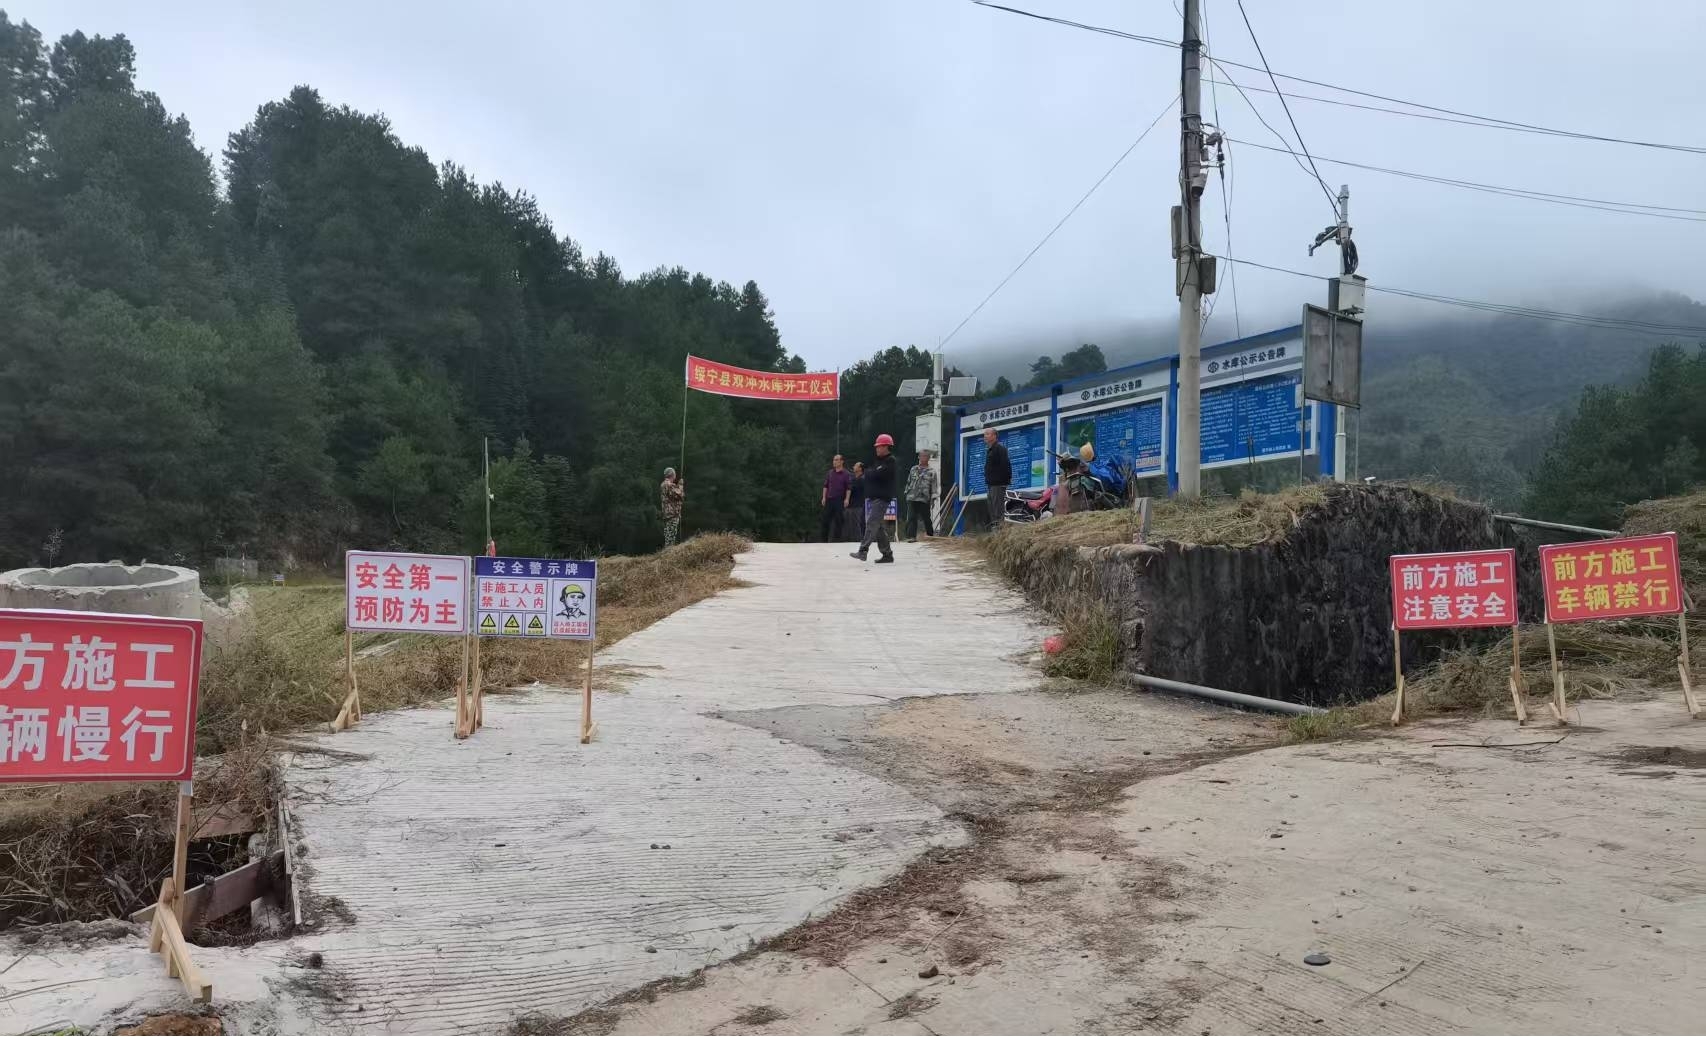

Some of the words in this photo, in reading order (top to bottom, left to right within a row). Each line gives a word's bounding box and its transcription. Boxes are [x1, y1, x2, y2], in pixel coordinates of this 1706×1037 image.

[1222, 347, 1286, 370] 水库公示公告牌
[694, 365, 833, 395] 绥宁县双冲水库开工仪式
[355, 562, 458, 591] 安全第一
[492, 560, 578, 576] 安全警示牌
[1401, 561, 1505, 590] 前方施工
[1552, 546, 1667, 581] 前方施工
[481, 581, 545, 595] 非施工人员
[481, 596, 544, 608] 禁止入内
[1556, 579, 1671, 613] 车辆禁行
[354, 596, 457, 625] 预防为主
[1403, 592, 1506, 621] 注意安全
[0, 632, 175, 691] 方施工
[0, 704, 173, 763] 辆慢行
